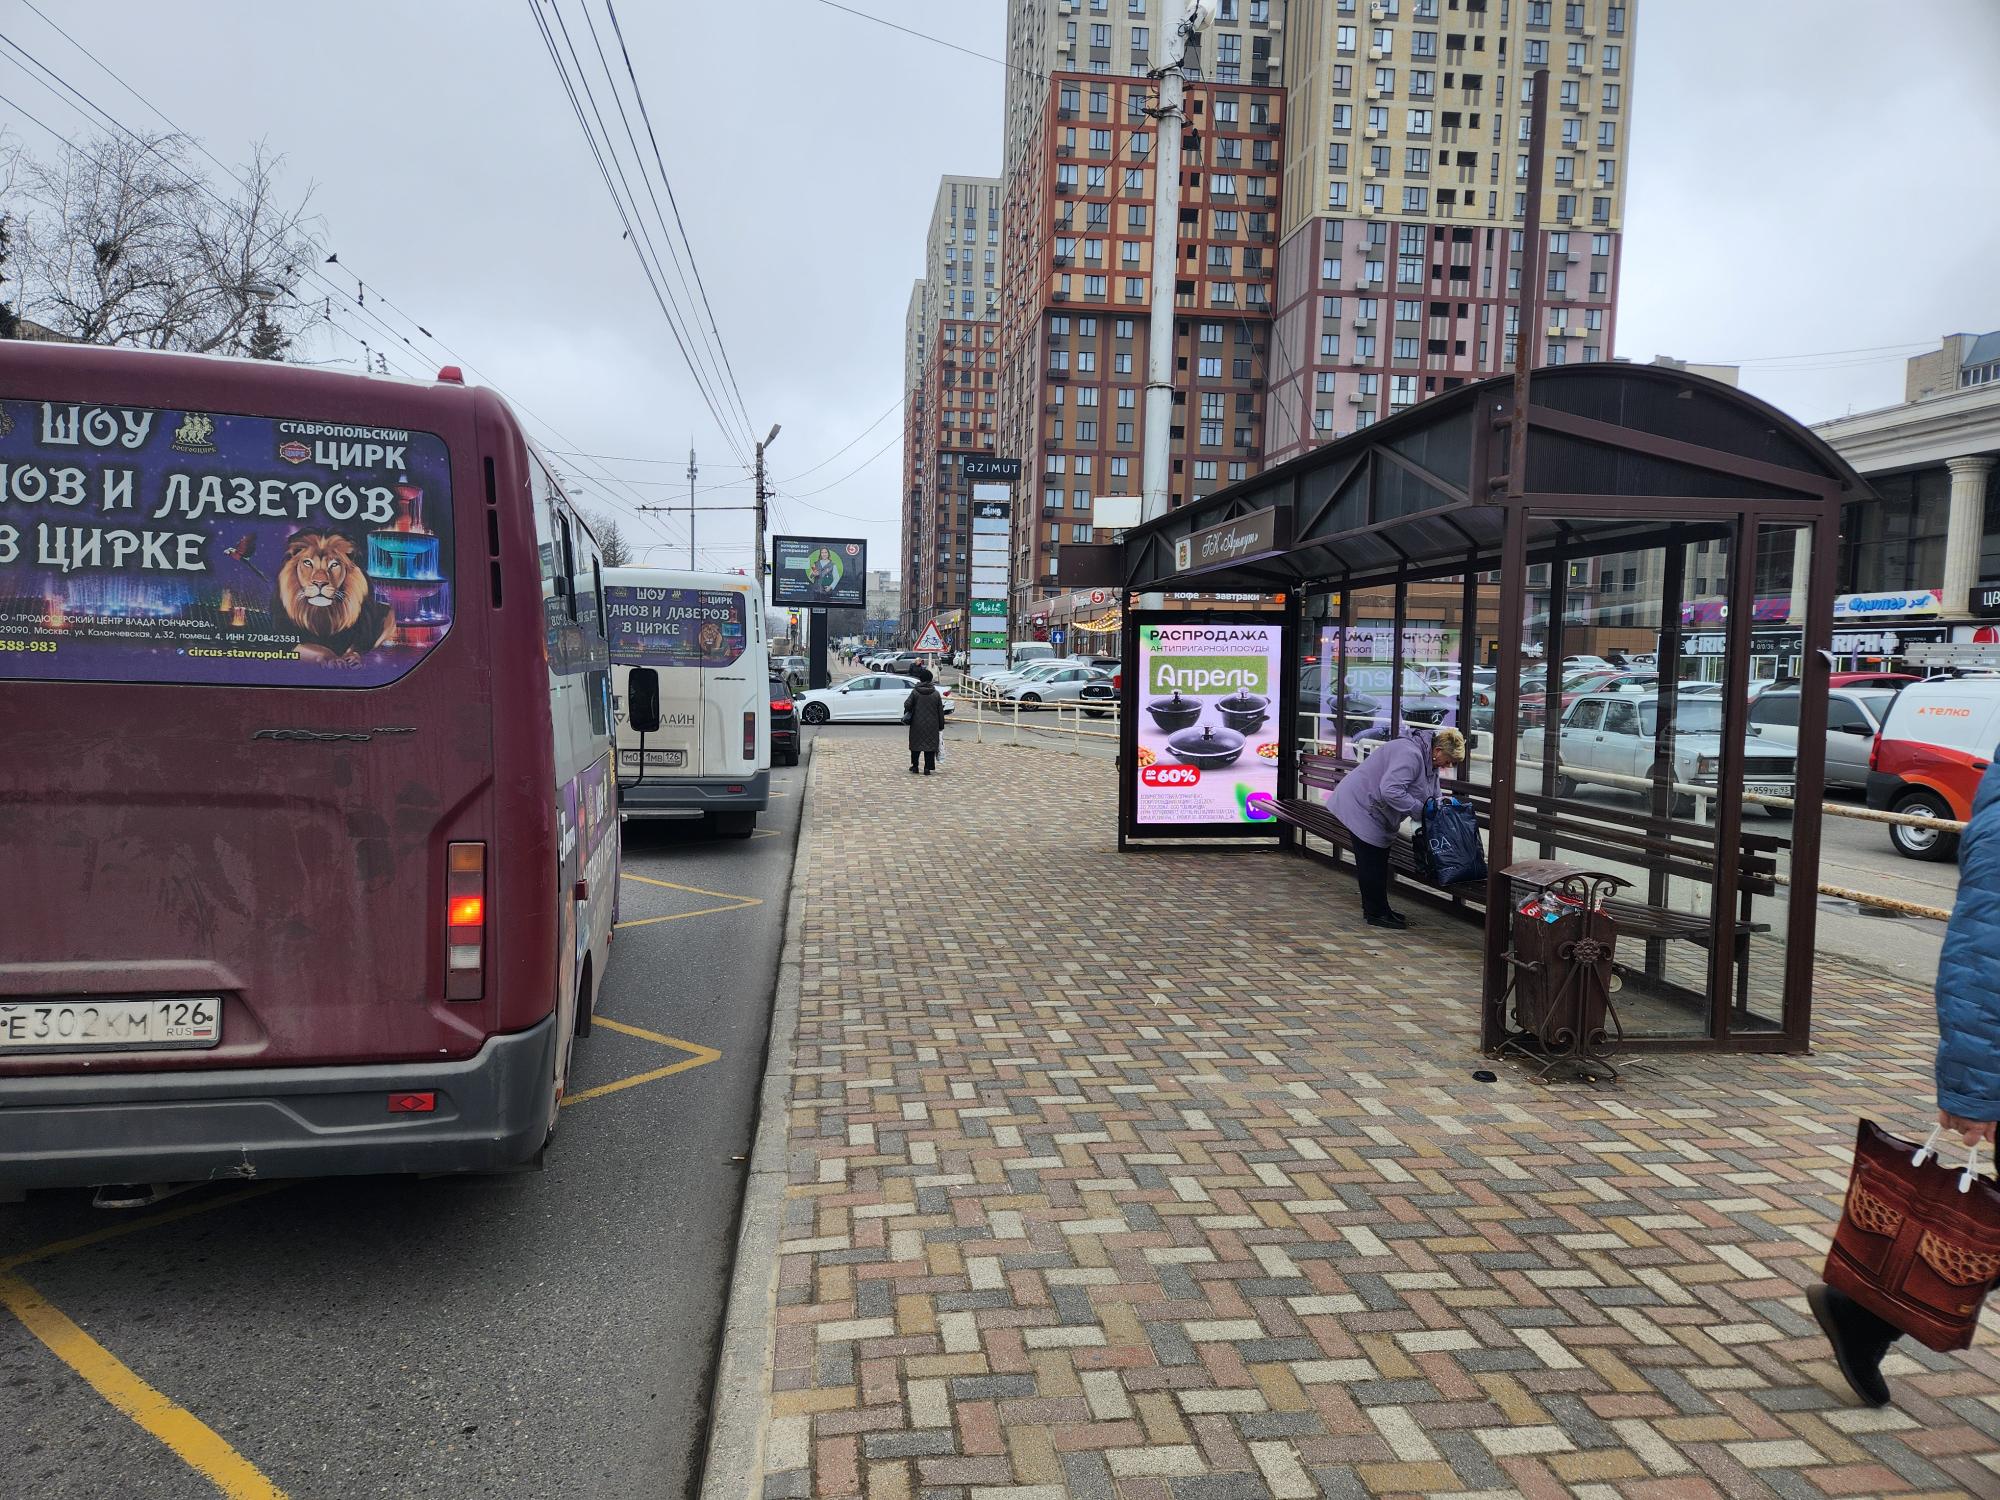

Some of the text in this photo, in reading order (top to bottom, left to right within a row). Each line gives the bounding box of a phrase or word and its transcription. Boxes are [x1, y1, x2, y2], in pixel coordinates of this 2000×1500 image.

[41, 402, 153, 449] ШОУ
[315, 440, 406, 470] ЦИРК
[0, 463, 395, 524] ОВ И ЛАЗЕРОВ
[37, 522, 207, 573] ЦИРКЕ
[636, 587, 666, 600] ШОУ
[707, 596, 733, 605] ЦИРК
[1174, 592, 1260, 602] кофе завтраки
[652, 607, 661, 618] И
[666, 607, 730, 621] ЛАЗЕРОВ
[96, 617, 123, 626] ЦЕНТР
[125, 618, 156, 627] ВЛАДА
[622, 621, 680, 635] В ЦИРКЕ
[1150, 630, 1269, 642] РАСПРОДАЖА
[188, 647, 300, 660] circus-stavropol.ru
[1150, 644, 1270, 653] АНТИПРИГАРНОЙ ПОСУДЫ
[1157, 663, 1259, 692] Апрель
[1157, 769, 1197, 783] 60%
[160, 1002, 207, 1026] 126
[166, 1027, 192, 1037] RUS
